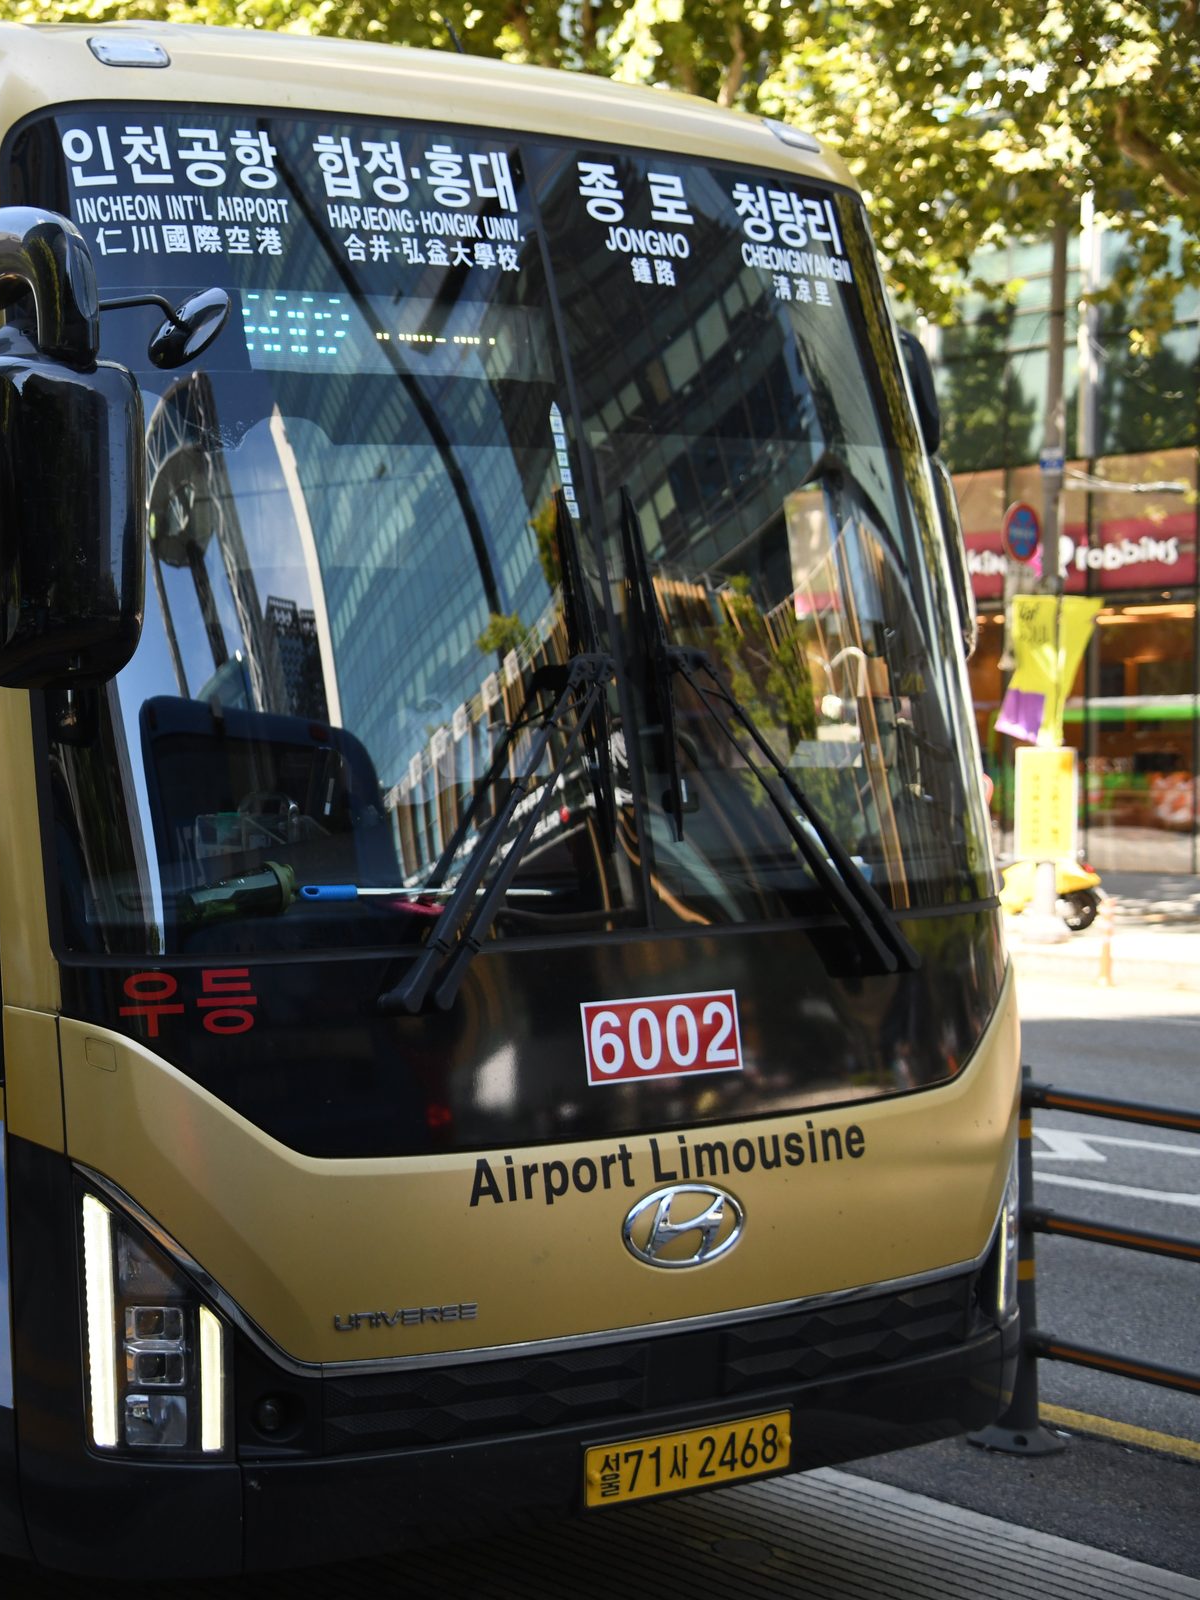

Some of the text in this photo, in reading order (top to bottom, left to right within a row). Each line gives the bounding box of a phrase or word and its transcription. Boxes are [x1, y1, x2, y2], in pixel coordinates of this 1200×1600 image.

[62, 126, 277, 190] 인천공항
[312, 135, 518, 213] 합정·홍대
[76, 194, 289, 224] INCHEON INT'L AIRPORT
[483, 215, 526, 243] UNIV.
[732, 182, 843, 256] 청량리
[95, 224, 284, 256] 仁川國際空港
[605, 226, 689, 259] JONGNO
[741, 242, 853, 284] CHEONGNYANGNI
[590, 1000, 738, 1075] 6002
[469, 1119, 867, 1208] Airport Limousine
[334, 1302, 478, 1332] UNIVERSE
[698, 1421, 780, 1480] 2468
